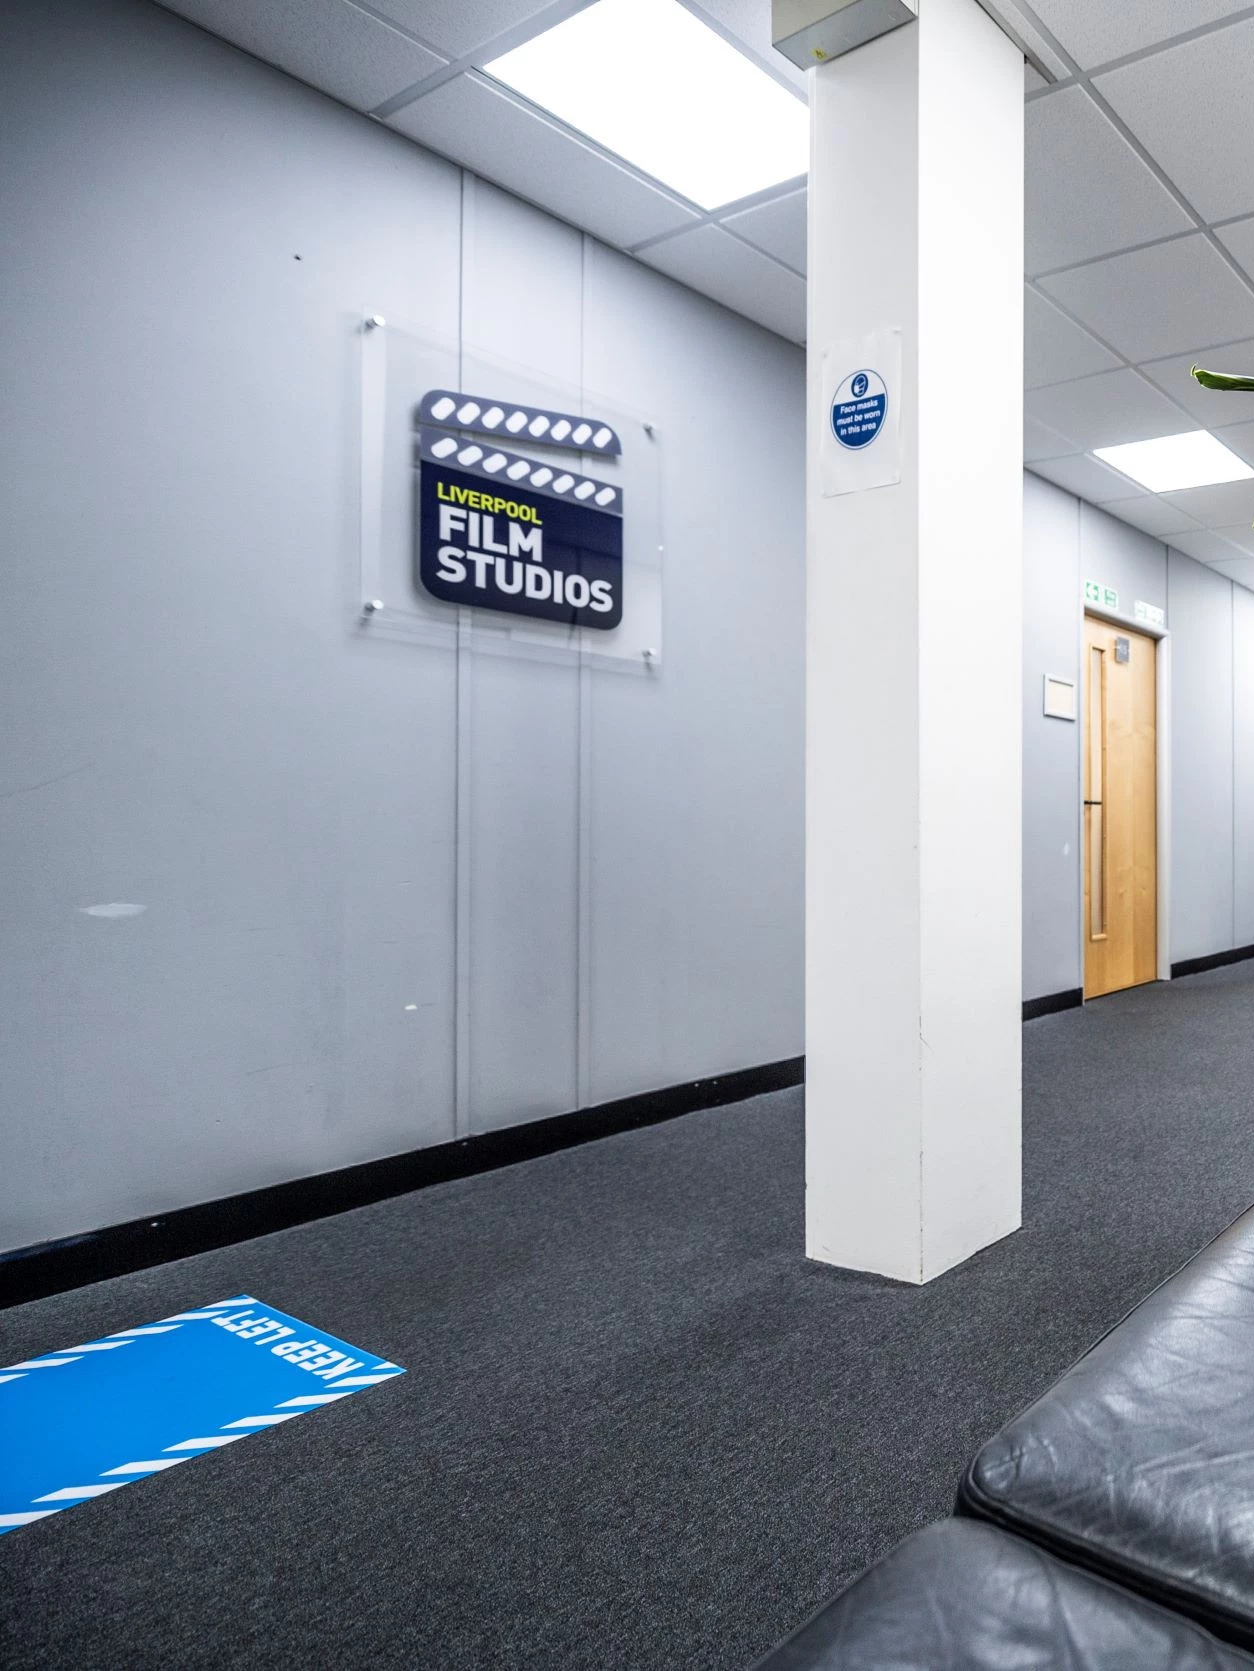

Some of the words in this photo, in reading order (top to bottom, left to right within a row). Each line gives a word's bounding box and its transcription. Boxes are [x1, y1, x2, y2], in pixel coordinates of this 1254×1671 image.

[837, 415, 853, 426] must
[854, 414, 863, 422] be
[864, 410, 881, 419] worn
[840, 405, 856, 414] Face
[857, 399, 878, 410] masks
[840, 427, 847, 436] in
[848, 424, 860, 434] this
[861, 422, 877, 431] area
[437, 482, 543, 525] LIVERPOOL
[438, 503, 543, 562] FILM
[436, 546, 614, 613] STUDIOS
[211, 1310, 297, 1346] LEFT
[270, 1340, 365, 1380] KEEP
